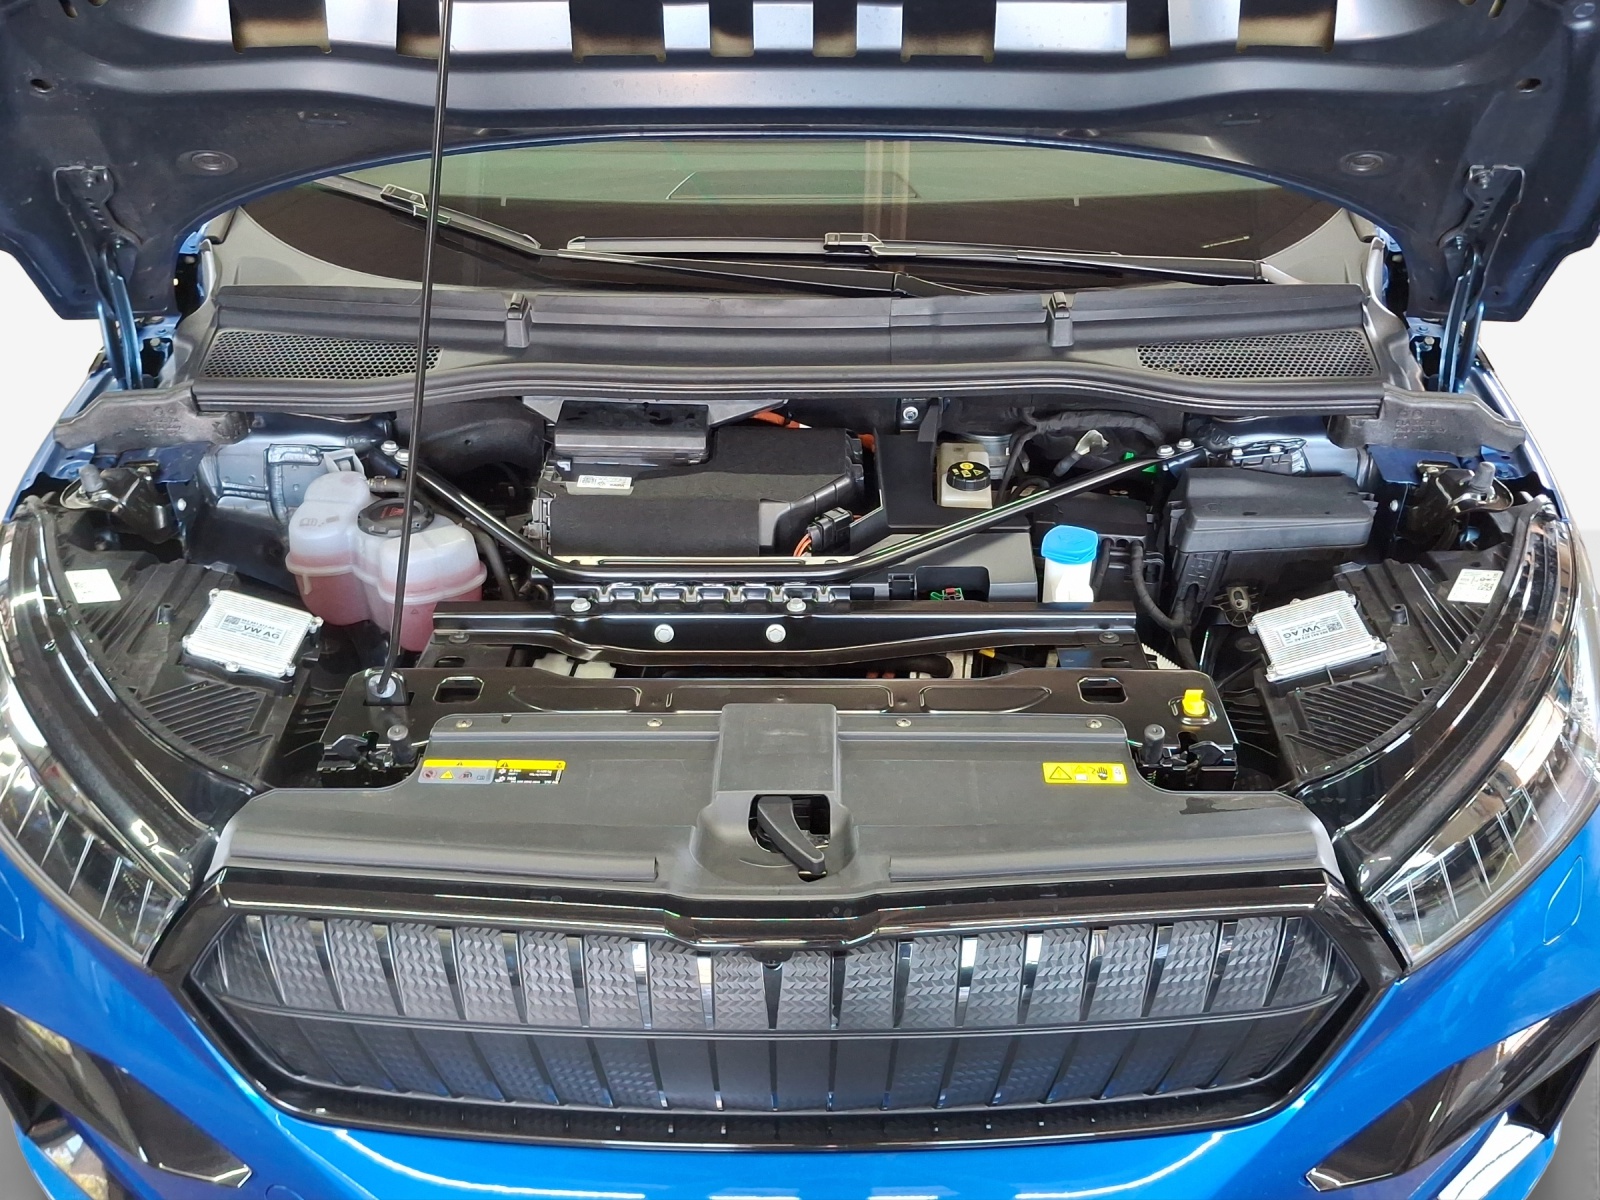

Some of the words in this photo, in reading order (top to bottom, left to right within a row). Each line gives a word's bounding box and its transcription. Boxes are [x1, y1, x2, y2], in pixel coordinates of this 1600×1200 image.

[244, 625, 262, 634] VW
[263, 631, 280, 640] AG
[1302, 625, 1321, 634] VW
[1283, 630, 1299, 639] AG
